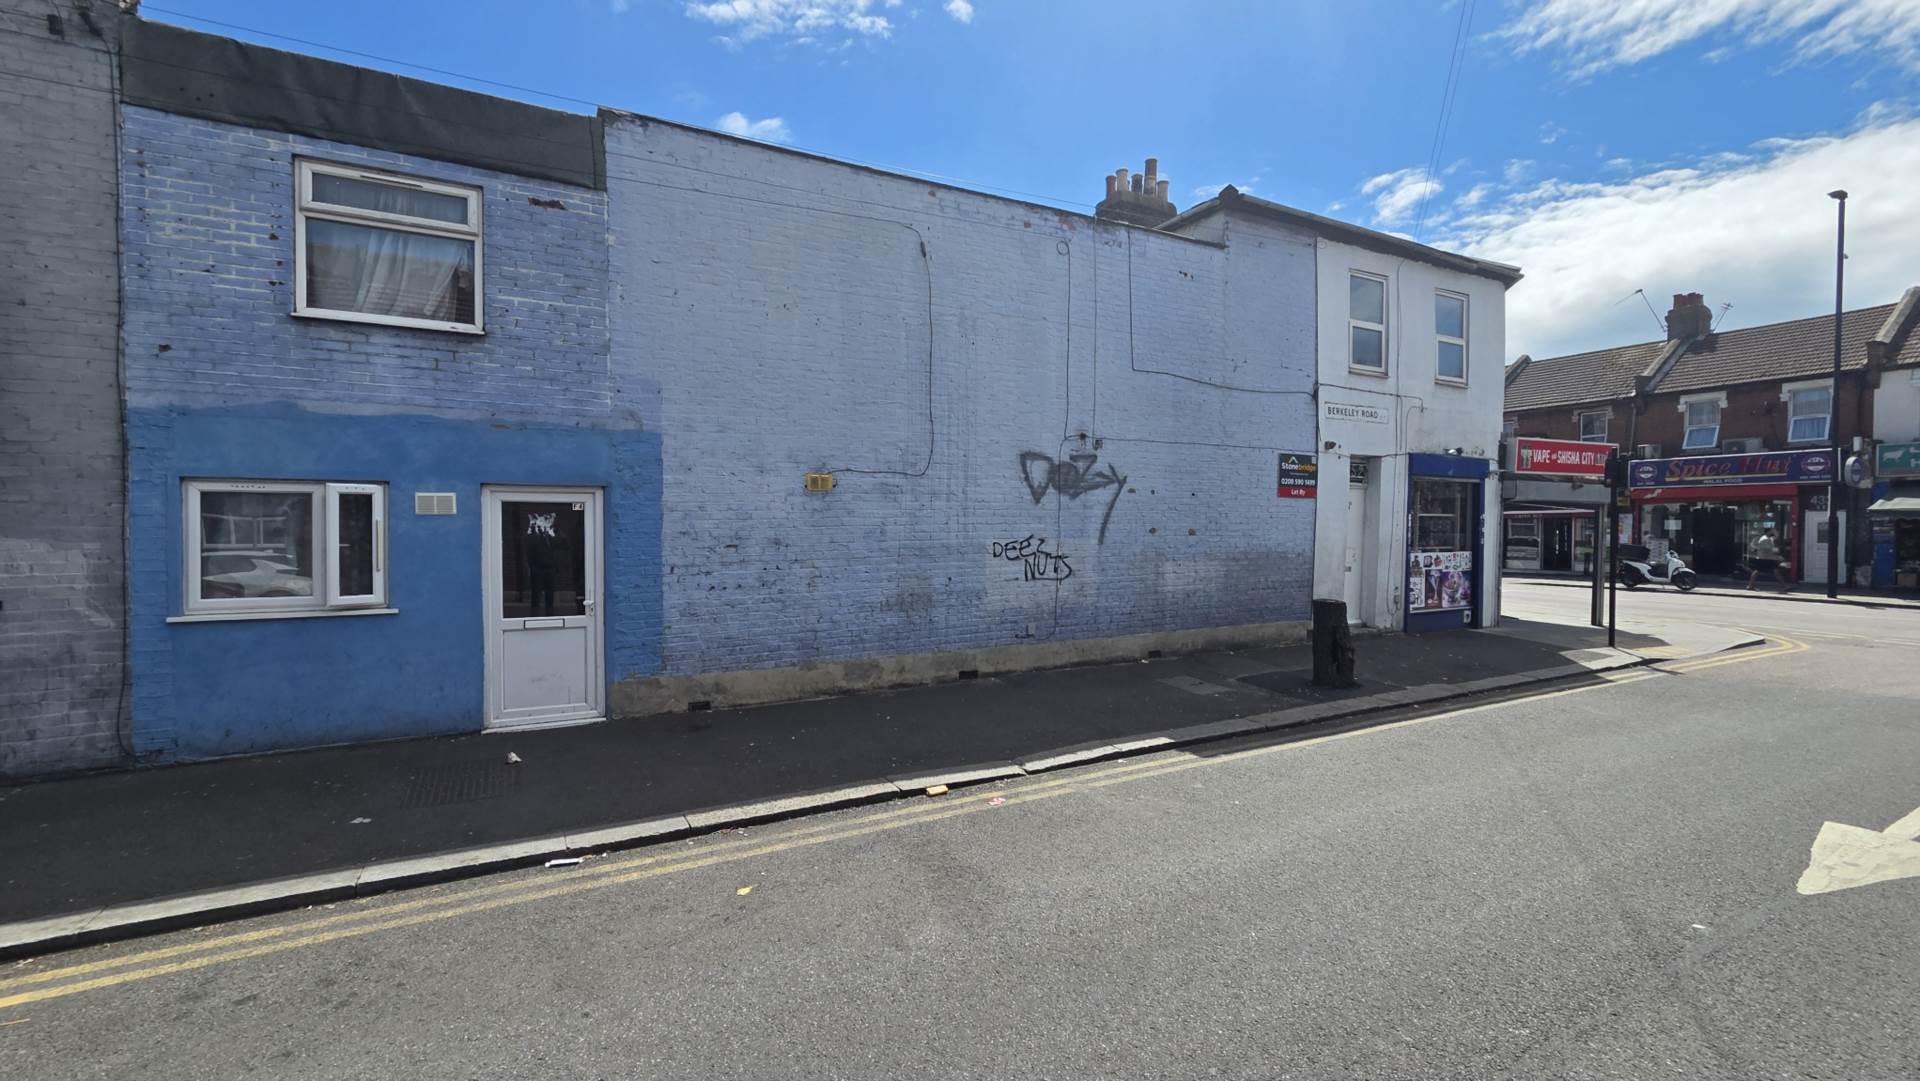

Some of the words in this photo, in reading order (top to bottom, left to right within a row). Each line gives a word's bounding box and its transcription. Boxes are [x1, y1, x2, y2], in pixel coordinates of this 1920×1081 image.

[1327, 406, 1359, 417] BERKELEY
[1361, 409, 1378, 419] ROAD
[1533, 449, 1551, 463] VAPE
[1557, 450, 1580, 465] SHISHA
[1581, 451, 1594, 465] CITY
[1281, 462, 1316, 472] Stonebridge
[1666, 460, 1732, 478] Spice
[1740, 455, 1792, 473] Hut
[1024, 553, 1073, 582] NUTS
